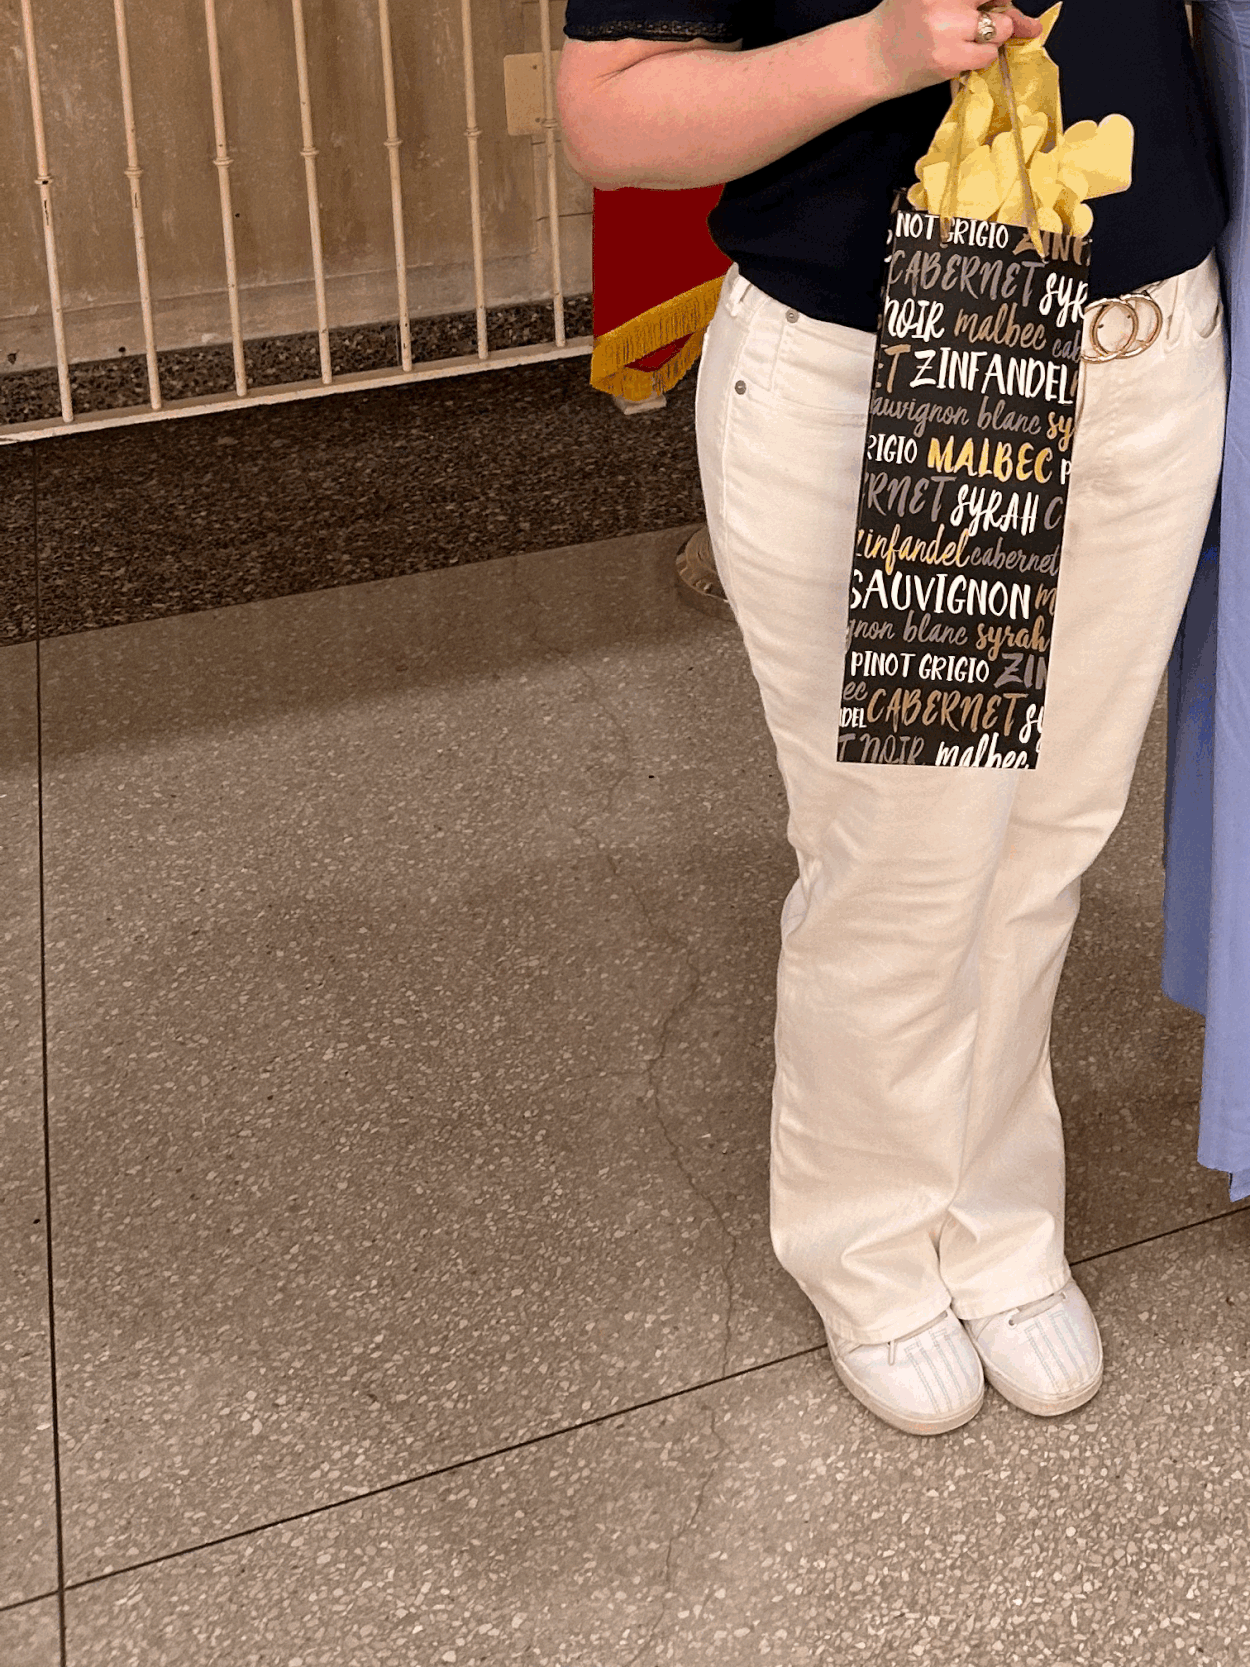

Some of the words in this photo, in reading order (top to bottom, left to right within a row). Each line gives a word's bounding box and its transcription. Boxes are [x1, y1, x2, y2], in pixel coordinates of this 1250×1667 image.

[895, 212, 940, 241] NOT
[888, 250, 1045, 307] CABERNET
[884, 296, 945, 343] NOIR
[954, 302, 1047, 351] malbec
[909, 347, 1074, 405] ZINFANDEL
[977, 395, 1041, 435] blanc
[927, 435, 1053, 484] MALBEC
[863, 472, 957, 523] RNET
[950, 483, 1040, 537] SYRAH
[970, 536, 1060, 577] cabernet
[850, 568, 1031, 620] SAUVIGNON
[903, 609, 968, 646] blanc
[975, 615, 1050, 662] syrah
[850, 650, 916, 678] PINOT
[918, 652, 989, 684] GRIGIO
[840, 706, 867, 728] DEL
[866, 687, 1029, 737] CABERNET
